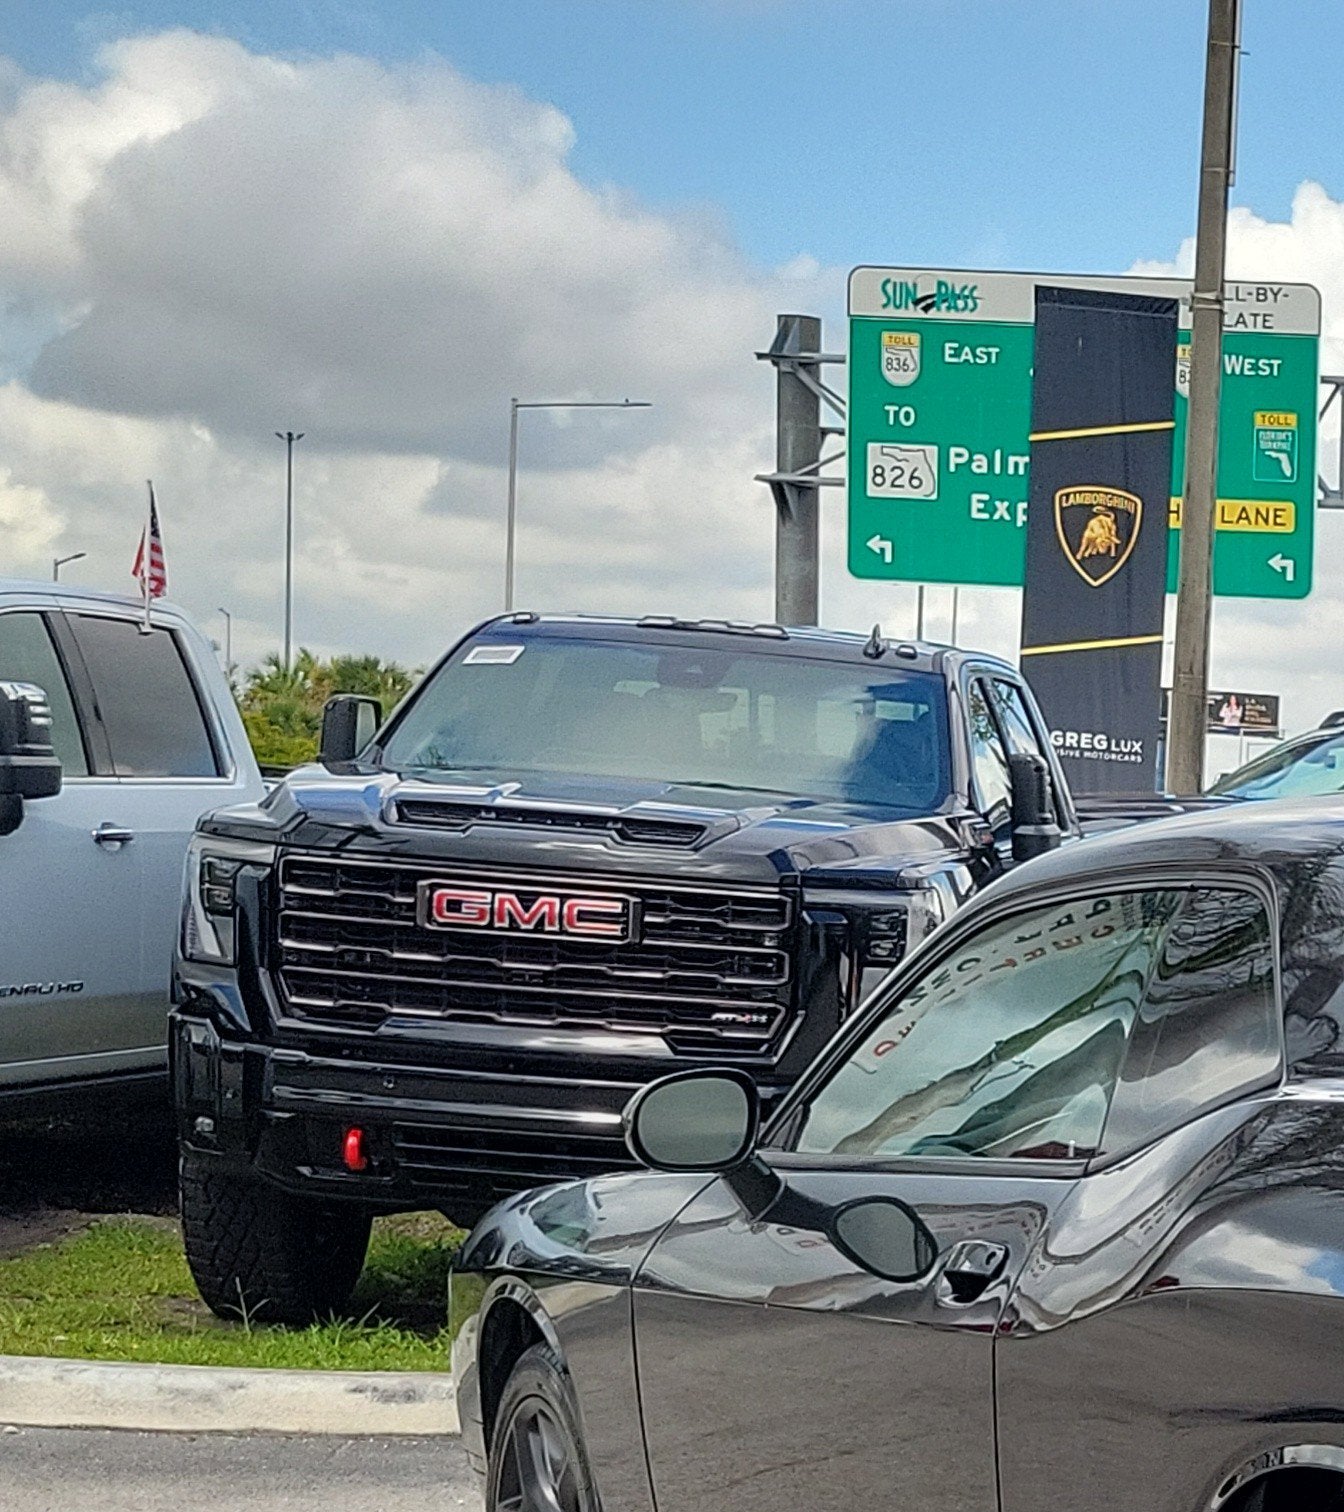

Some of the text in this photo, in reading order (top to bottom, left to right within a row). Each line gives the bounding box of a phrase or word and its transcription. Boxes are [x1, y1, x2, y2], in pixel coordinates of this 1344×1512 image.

[881, 278, 917, 310] SUN
[888, 335, 914, 346] TOLL
[944, 343, 1000, 364] EAST
[885, 356, 910, 373] 836
[1223, 353, 1282, 376] WEST
[884, 405, 916, 427] TO
[1260, 414, 1292, 426] TOLL
[872, 464, 923, 489] 826
[1221, 505, 1287, 526] LANE
[1083, 750, 1143, 763] MOTORCARS
[1111, 739, 1143, 753] LUX
[433, 889, 624, 936] GMC
